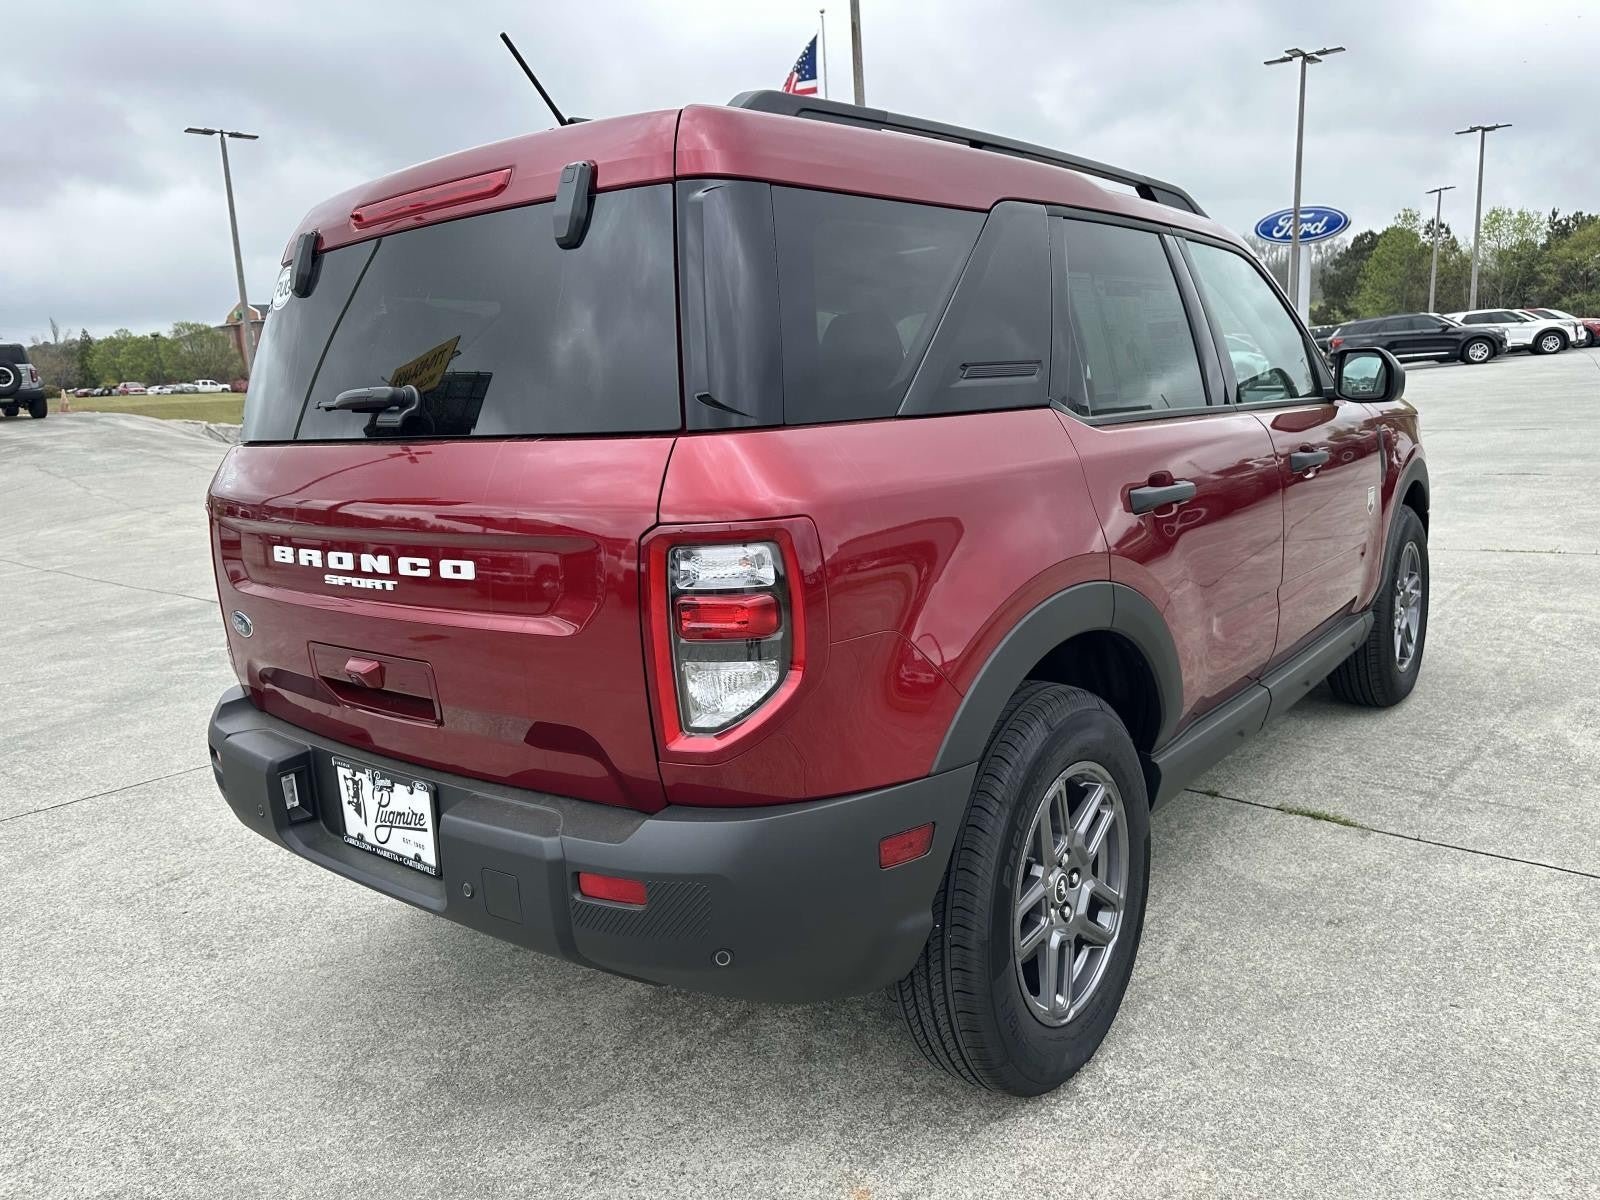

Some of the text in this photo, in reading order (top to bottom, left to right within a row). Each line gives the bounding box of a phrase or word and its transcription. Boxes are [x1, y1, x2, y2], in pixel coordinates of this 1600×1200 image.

[272, 545, 476, 581] BRONCO
[324, 574, 399, 591] SPORT
[372, 788, 428, 845] Pugmire
[376, 847, 399, 862] MARIETTA
